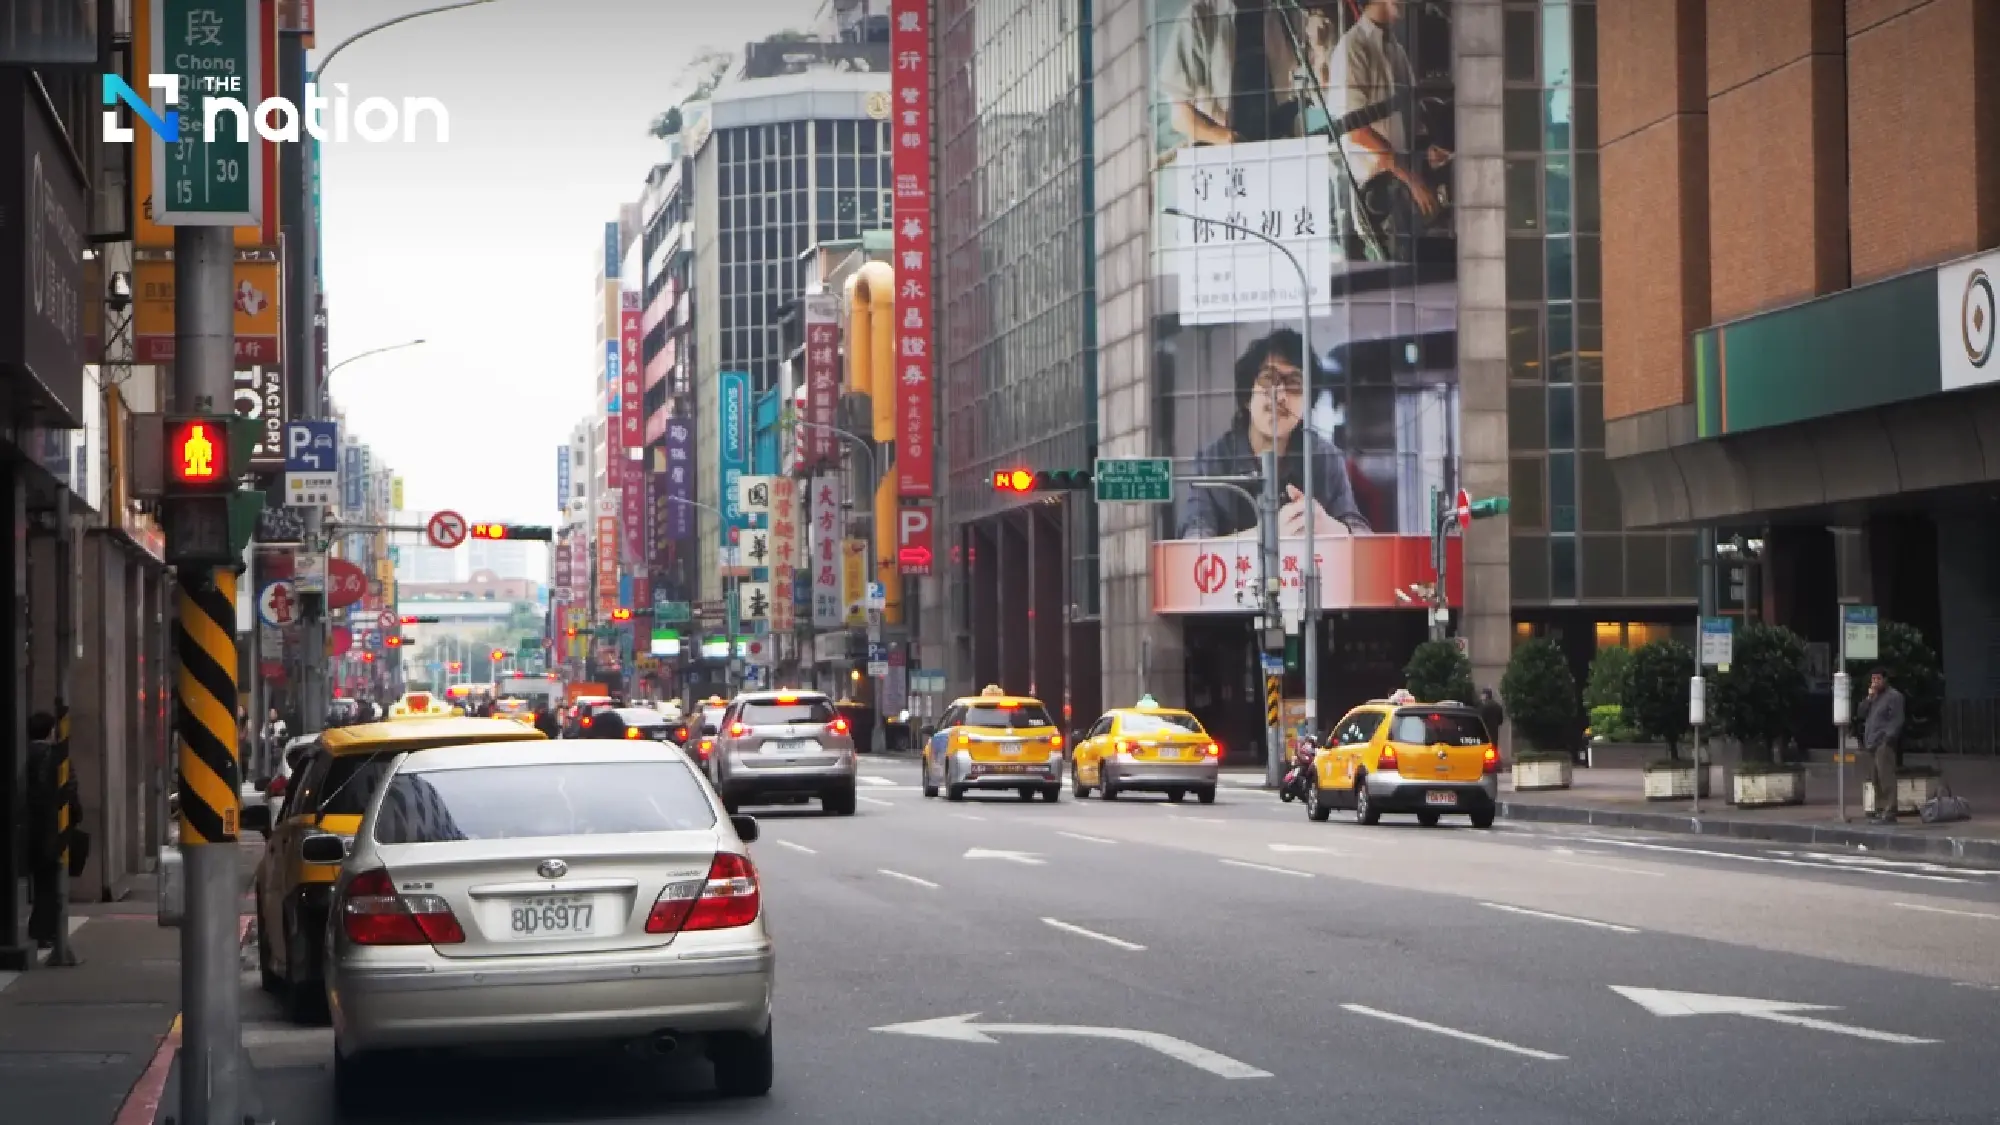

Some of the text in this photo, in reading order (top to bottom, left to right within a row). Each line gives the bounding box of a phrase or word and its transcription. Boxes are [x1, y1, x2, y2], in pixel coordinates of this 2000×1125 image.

[185, 8, 224, 46] 段
[175, 54, 236, 74] Chong
[174, 137, 194, 160] 37
[216, 159, 239, 182] 30
[176, 180, 192, 203] 15
[265, 371, 281, 453] FACTORY
[728, 387, 738, 450] watsons
[289, 425, 311, 460] P
[901, 511, 928, 544] P
[511, 905, 593, 936] 8D-6977
